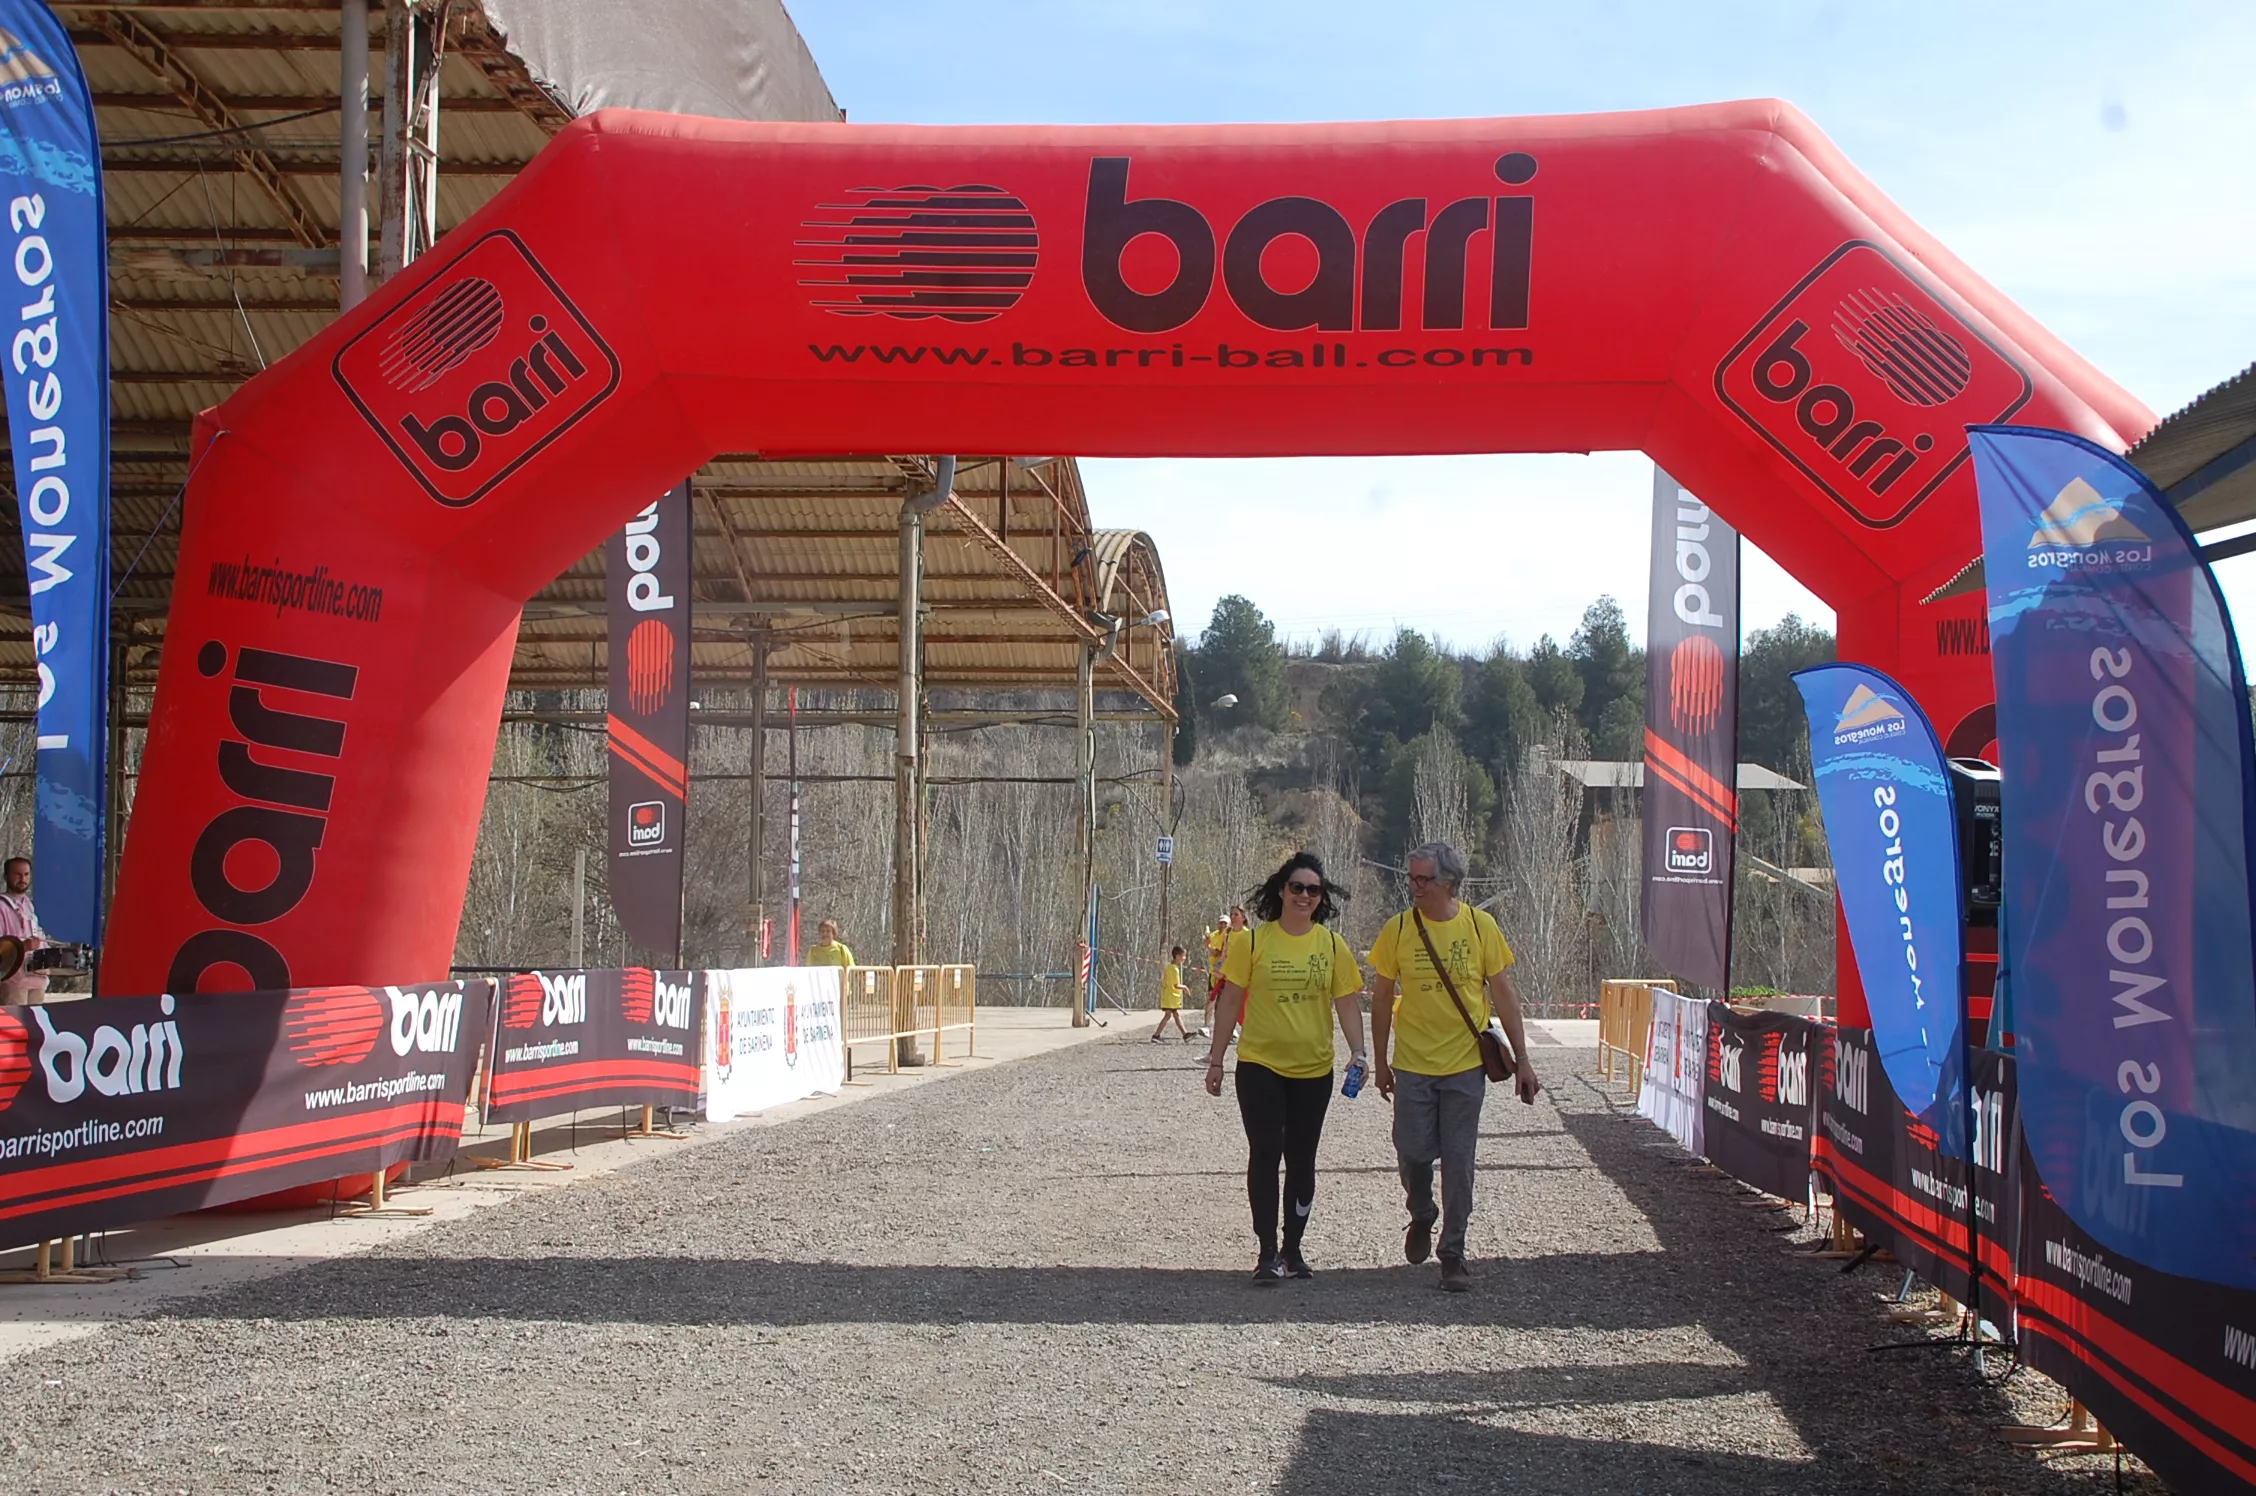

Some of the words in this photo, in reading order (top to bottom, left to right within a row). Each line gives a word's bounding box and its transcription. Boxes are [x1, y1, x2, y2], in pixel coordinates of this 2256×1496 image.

[1081, 152, 1539, 334] barri
[807, 342, 1535, 369] www.barri-ball.com
[399, 314, 587, 472] barri
[1751, 318, 1934, 498] barri
[207, 553, 383, 623] www.barrisportline.com
[386, 979, 466, 1057] barri
[530, 969, 586, 1027] barri
[654, 969, 693, 1030] barri
[30, 994, 184, 1103] barri
[505, 1039, 579, 1063] www.barrisportline.com
[1777, 1031, 1807, 1107] barri
[1834, 1028, 1871, 1116] barri
[304, 1071, 446, 1110] www.barrisportline.com
[2045, 1237, 2132, 1305] www.barrisportline.com
